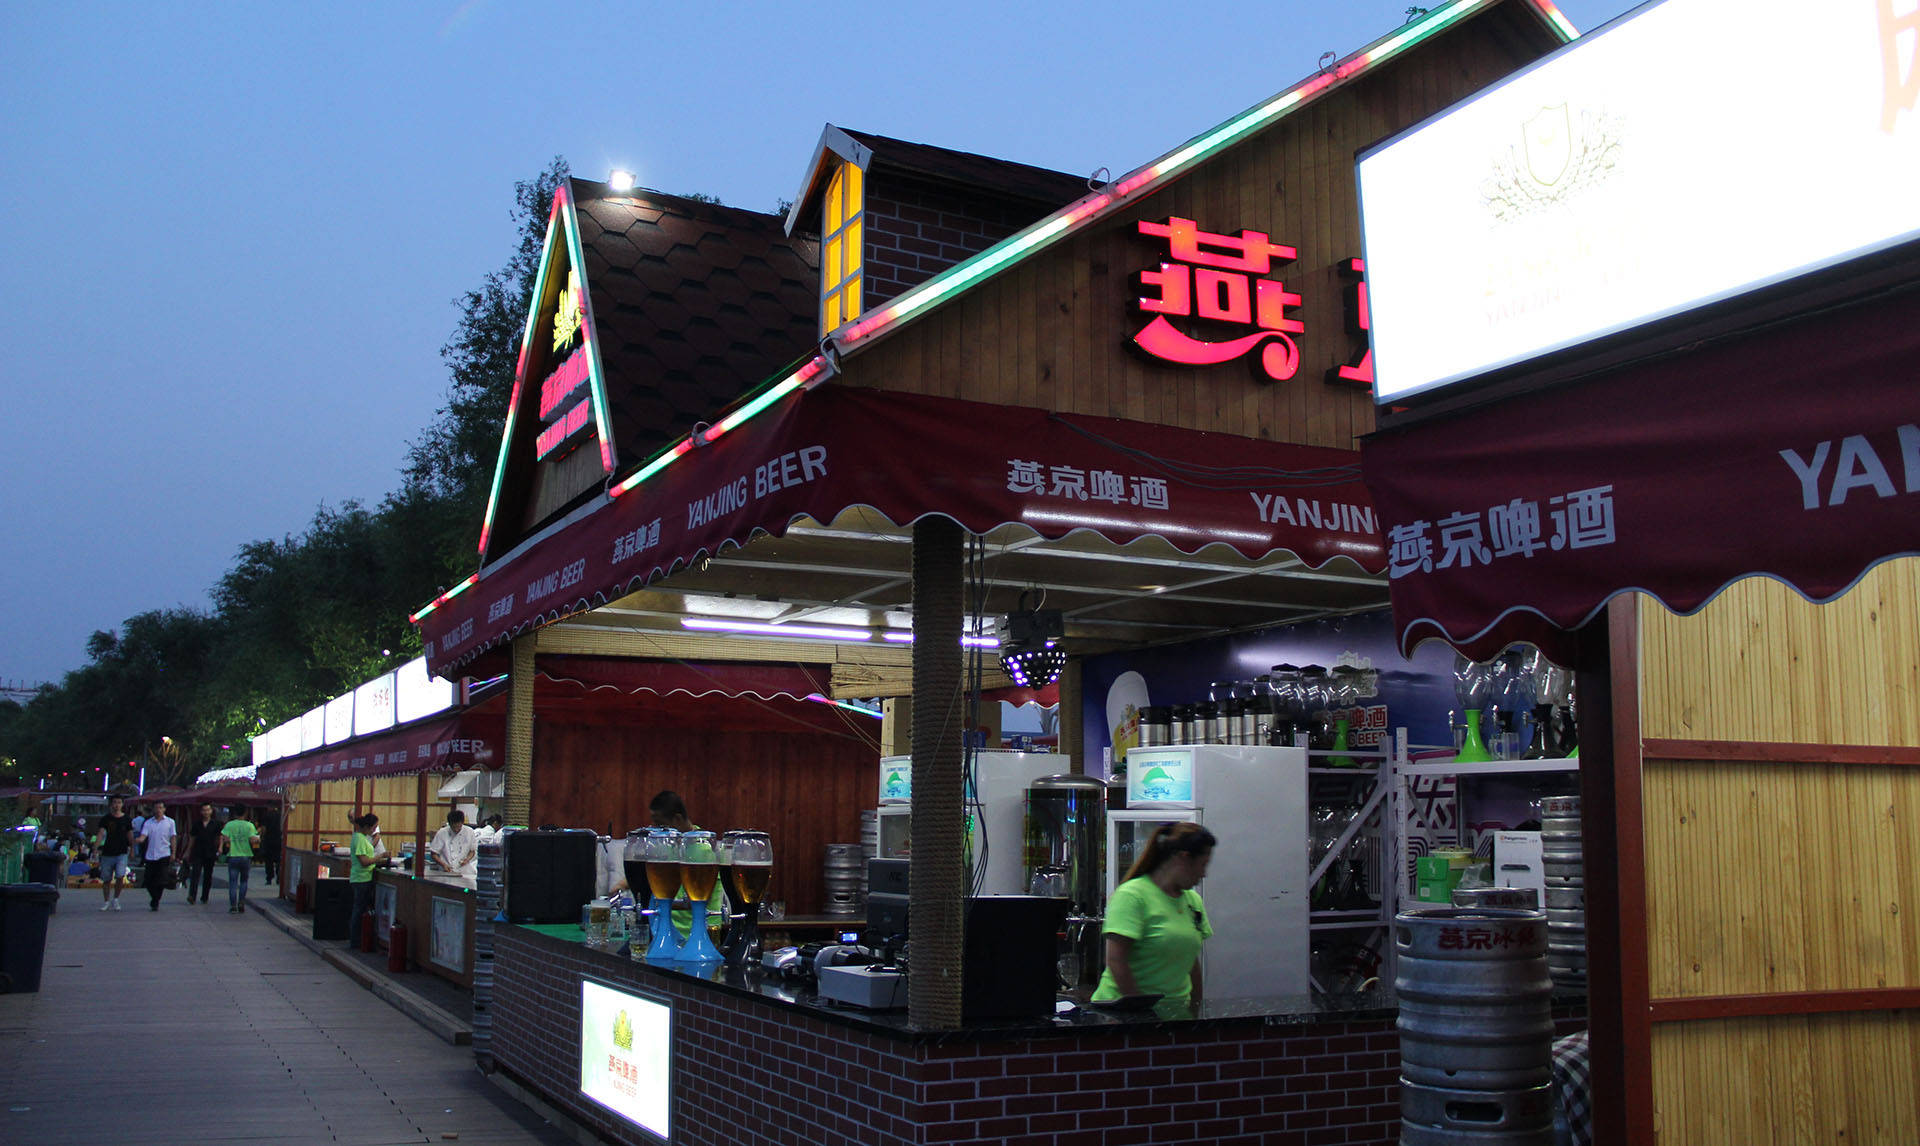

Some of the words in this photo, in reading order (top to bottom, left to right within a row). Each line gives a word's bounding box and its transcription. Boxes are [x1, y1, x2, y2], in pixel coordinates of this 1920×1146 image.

[687, 475, 748, 530] YANJING
[755, 445, 828, 500] BEER
[1006, 459, 1170, 511] 燕京啤酒
[1249, 492, 1380, 534] YANJIN
[1387, 484, 1617, 580] 燕京啤酒
[611, 517, 662, 565] 燕京啤酒
[559, 558, 586, 589] BEER
